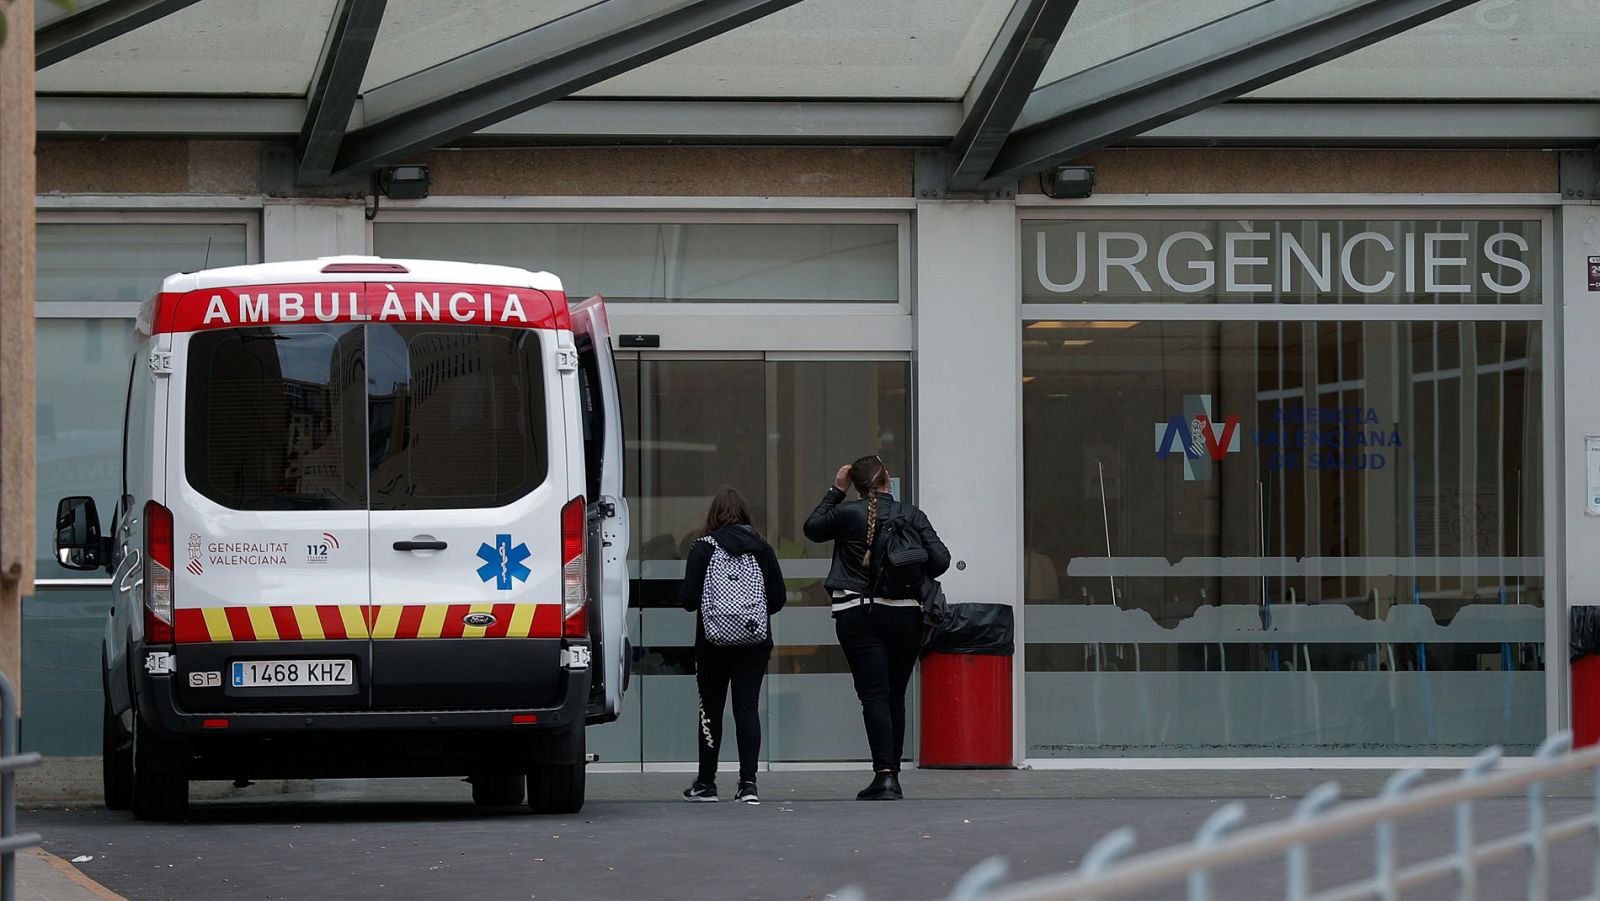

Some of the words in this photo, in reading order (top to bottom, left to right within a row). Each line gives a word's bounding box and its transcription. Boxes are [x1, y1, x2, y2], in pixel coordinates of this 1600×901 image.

[1036, 220, 1531, 294] URGÈNCIES
[203, 285, 528, 325] AMBULÀNCIA
[1272, 408, 1379, 424] AGENCIA
[1251, 431, 1402, 448] VALENCIANA
[1269, 454, 1297, 470] DE
[1307, 454, 1386, 470] SALUD
[208, 542, 289, 553] GENERALITAT
[307, 544, 328, 555] 112
[209, 555, 287, 565] VALENCIANA
[469, 614, 490, 624] Ford
[192, 673, 218, 686] SP
[250, 664, 299, 683] 1468
[308, 663, 346, 682] KHZ
